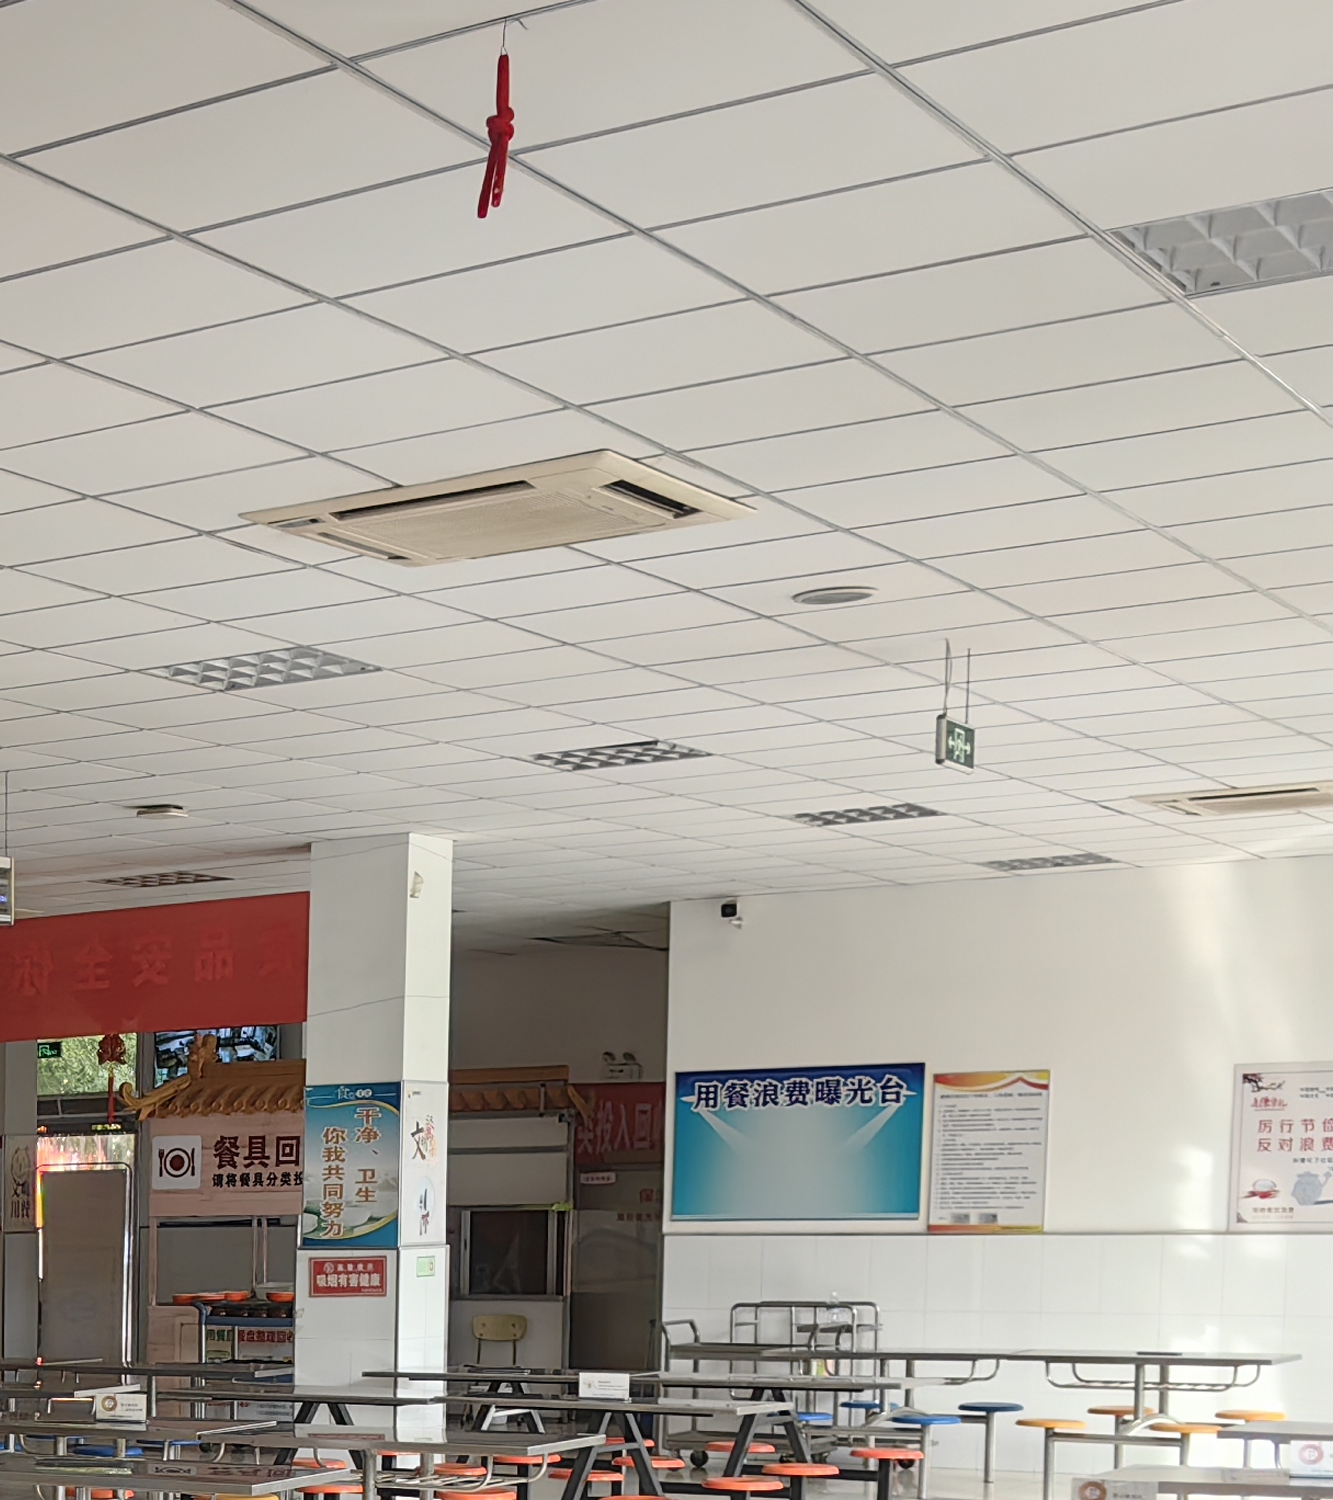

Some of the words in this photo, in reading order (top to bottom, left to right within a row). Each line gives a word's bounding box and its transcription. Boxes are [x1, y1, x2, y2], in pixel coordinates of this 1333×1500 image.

[692, 1076, 906, 1110] 用餐浪费曝光台
[321, 1126, 348, 1238] 你我共同努力
